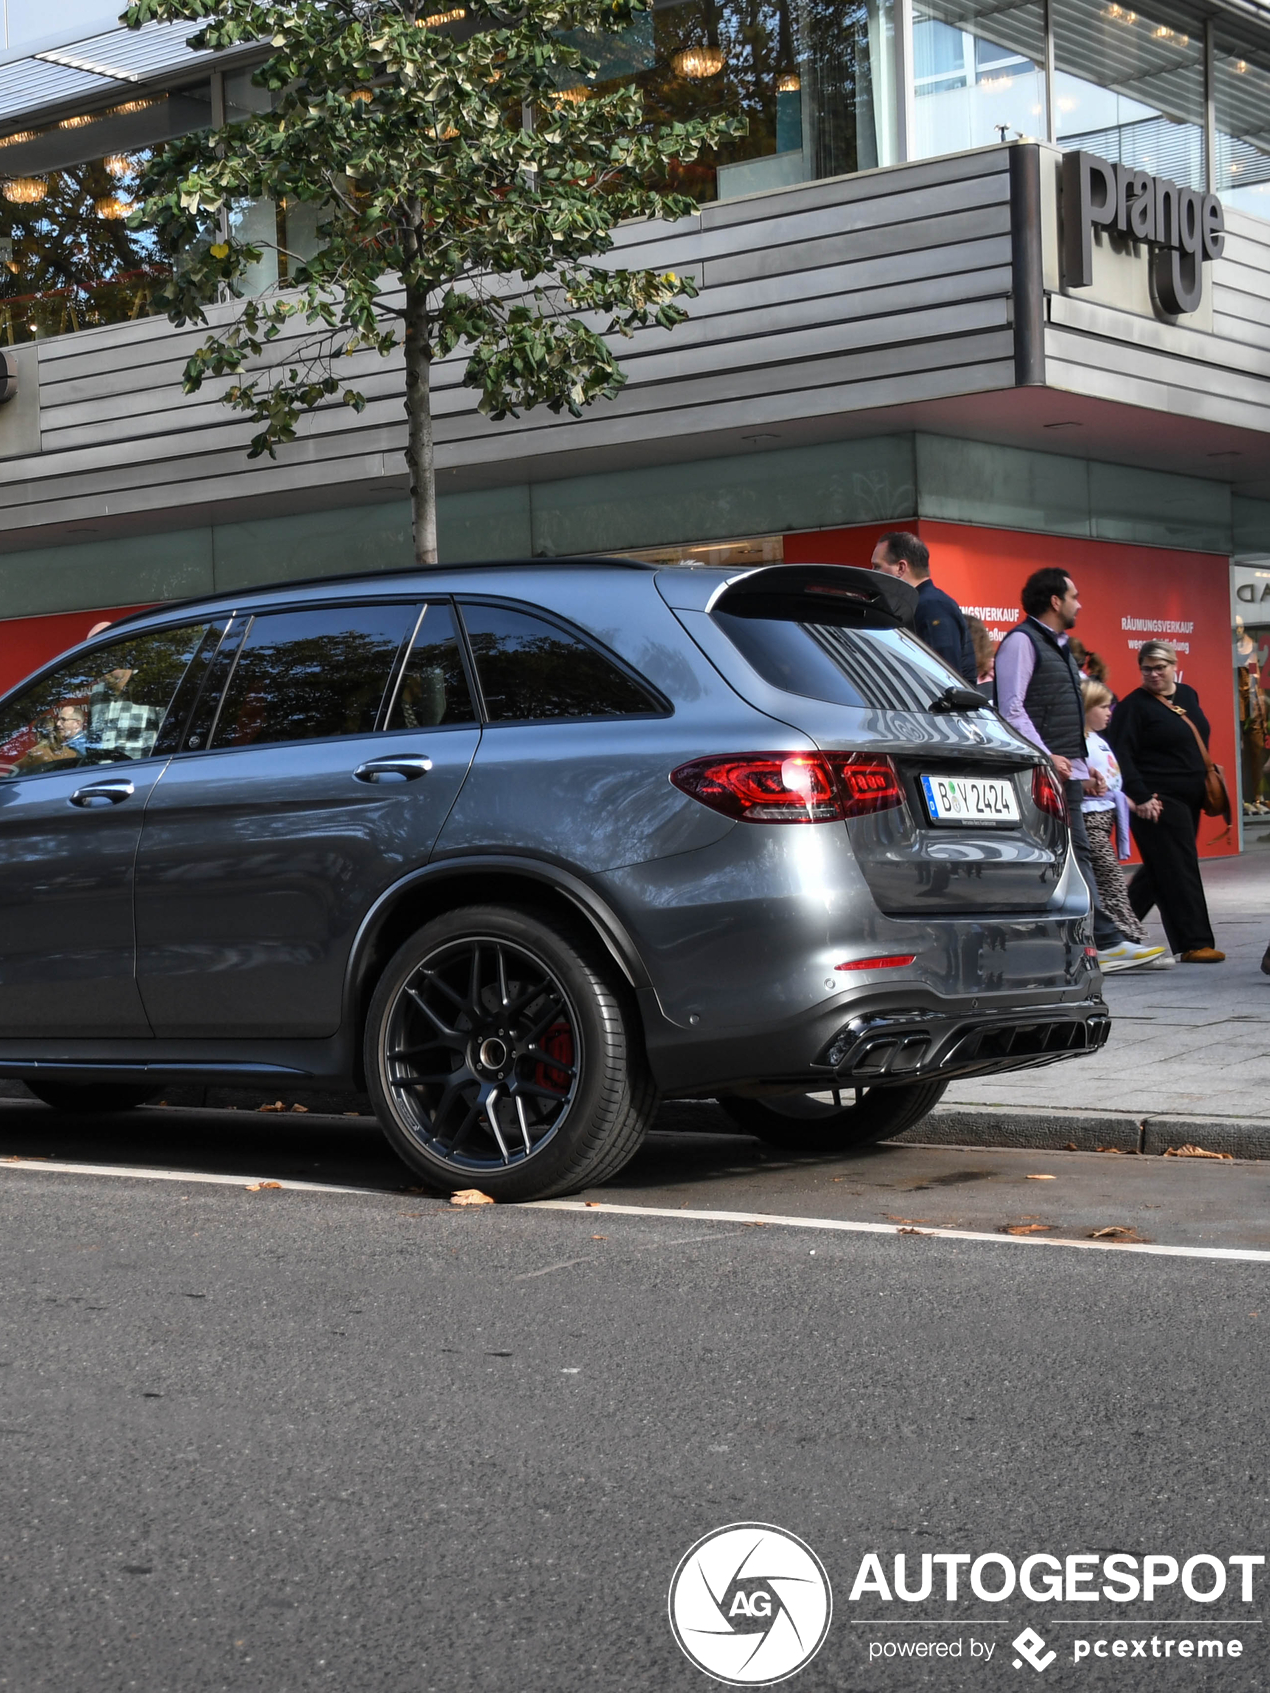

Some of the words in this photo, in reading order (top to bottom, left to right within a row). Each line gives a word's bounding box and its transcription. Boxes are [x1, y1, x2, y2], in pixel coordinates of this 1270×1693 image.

[1063, 151, 1225, 315] prange
[1121, 615, 1194, 634] RÄUMUNGSVERKAUF
[938, 782, 952, 812] B
[957, 783, 970, 812] Y
[971, 784, 1010, 814] 2424
